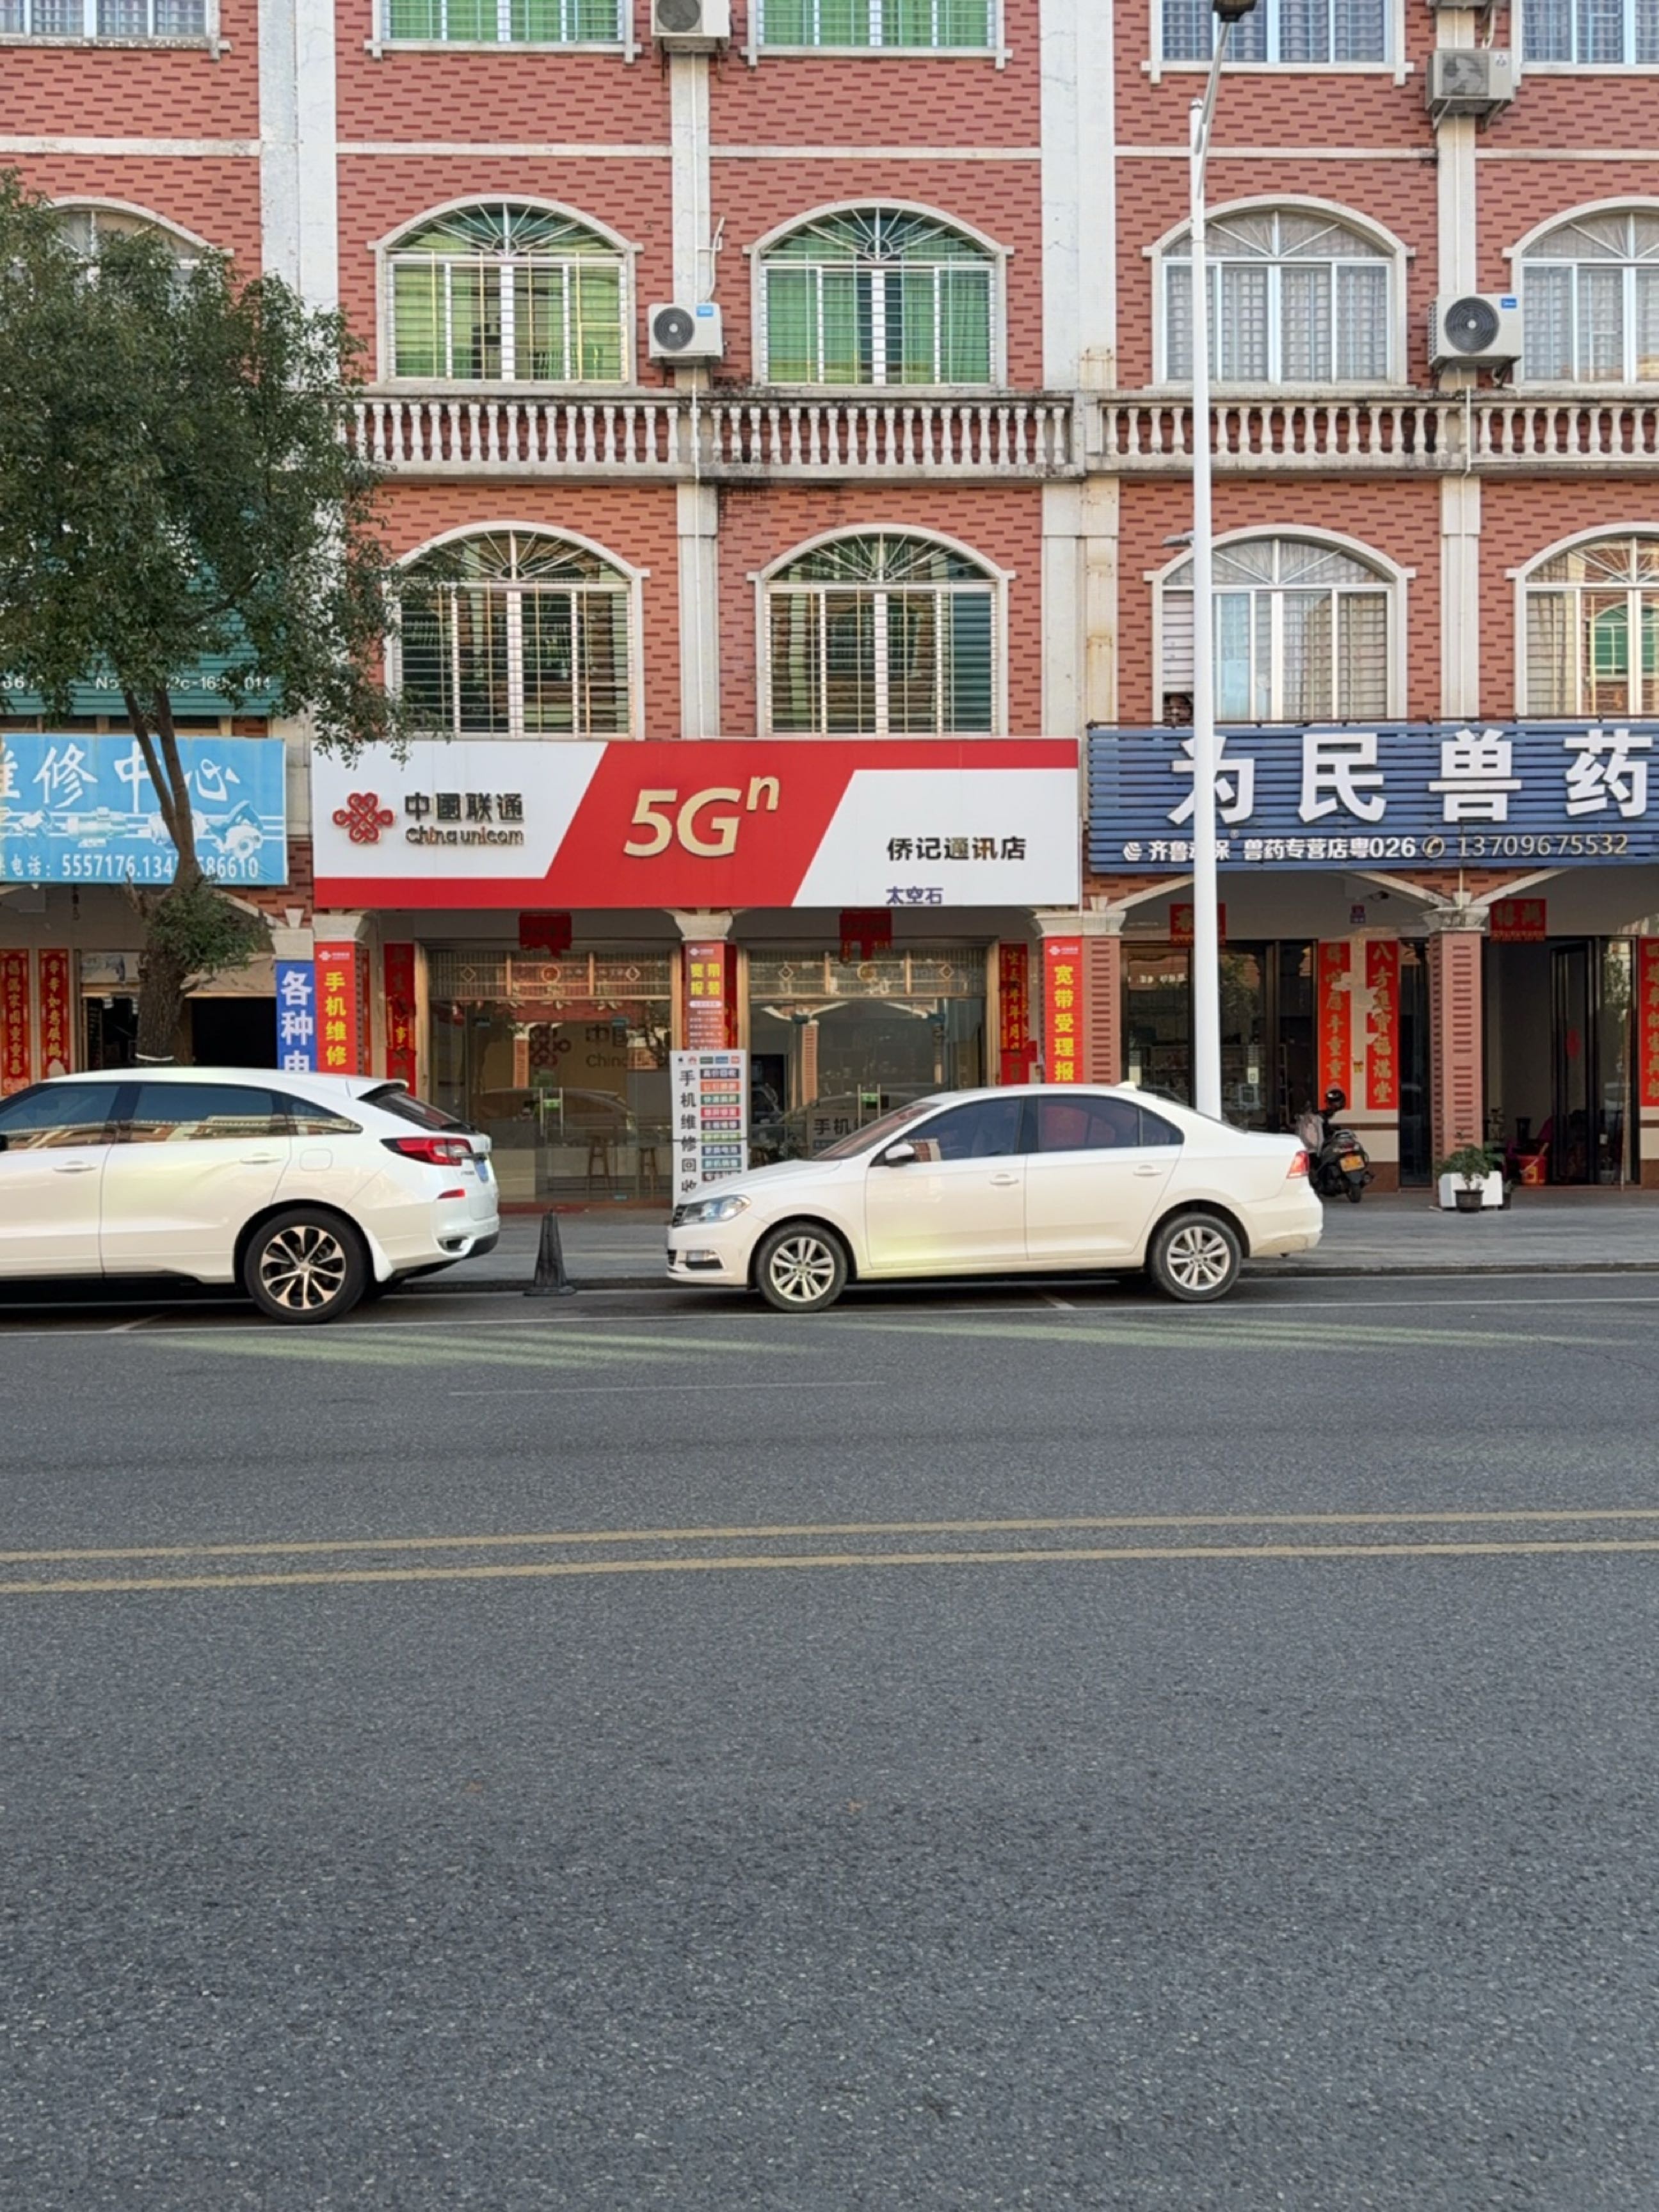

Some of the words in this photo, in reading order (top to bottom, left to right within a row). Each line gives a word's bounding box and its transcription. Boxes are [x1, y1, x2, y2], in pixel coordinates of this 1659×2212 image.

[1167, 728, 1653, 825] 为民兽药
[886, 837, 1027, 860] 侨记通讯店
[1458, 835, 1628, 857] 13709675532
[886, 886, 944, 904] 太空石
[325, 972, 347, 1066] 手机维修
[679, 1070, 697, 1193] 手机维修回收
